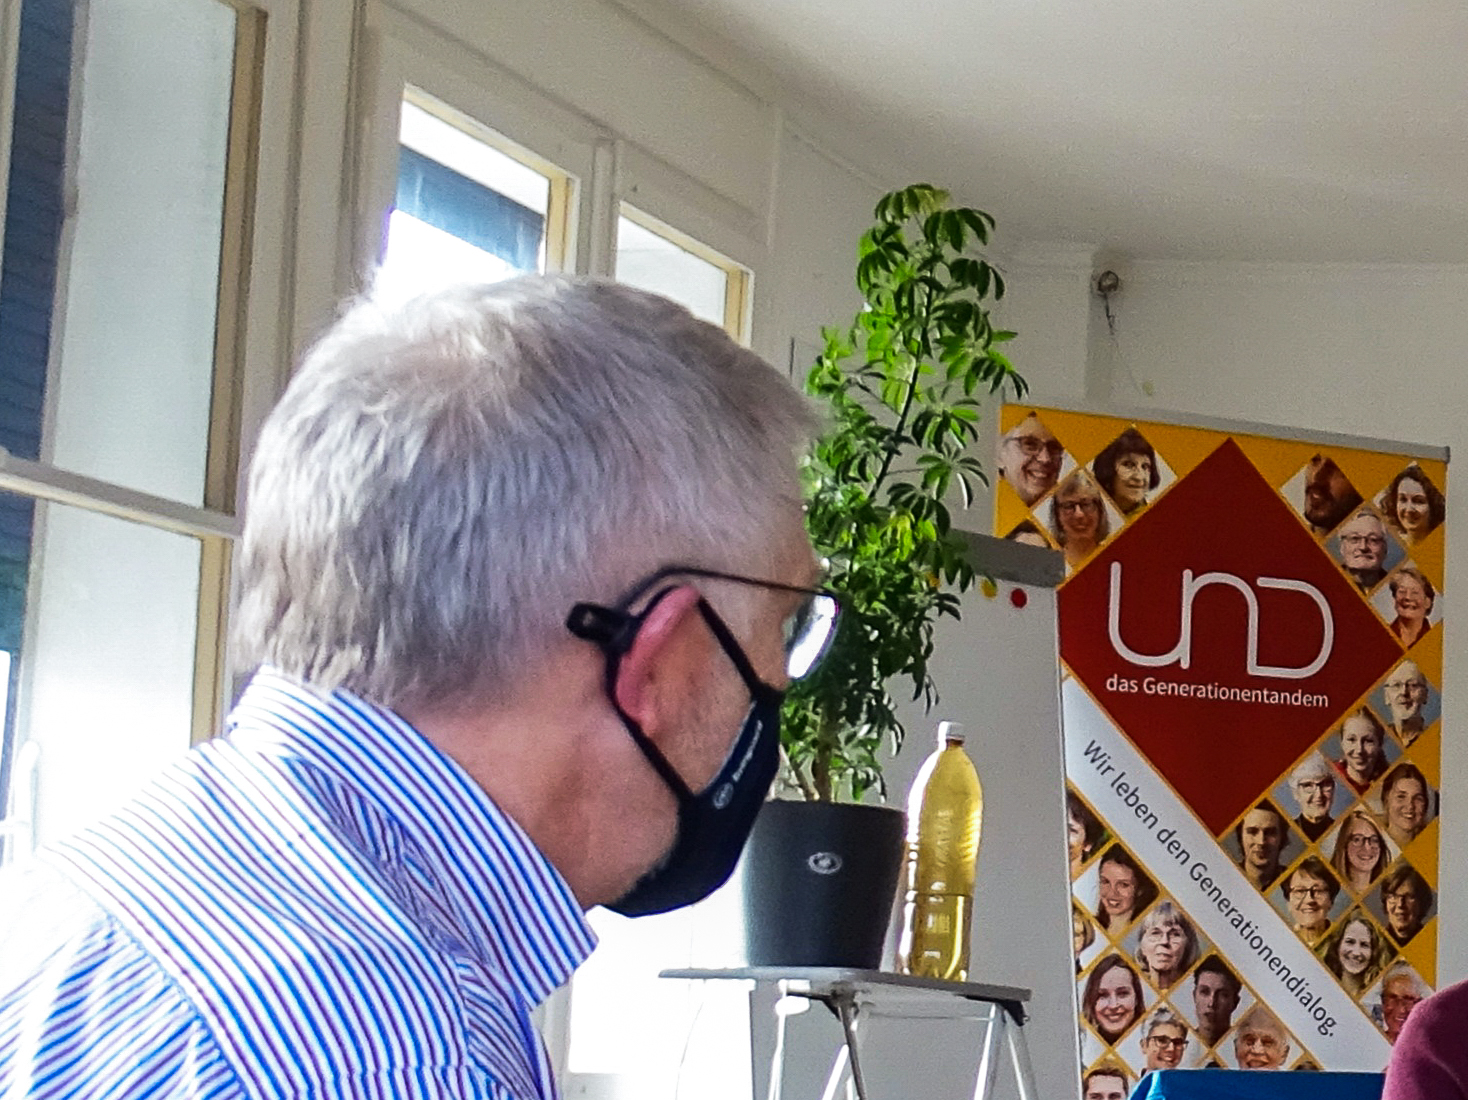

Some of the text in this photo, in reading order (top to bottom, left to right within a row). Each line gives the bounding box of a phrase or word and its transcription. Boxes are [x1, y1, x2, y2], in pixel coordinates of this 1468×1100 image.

[1105, 673, 1330, 708] das Generationentandem
[1083, 739, 1338, 1038] Wir leben den Generationendialog.
